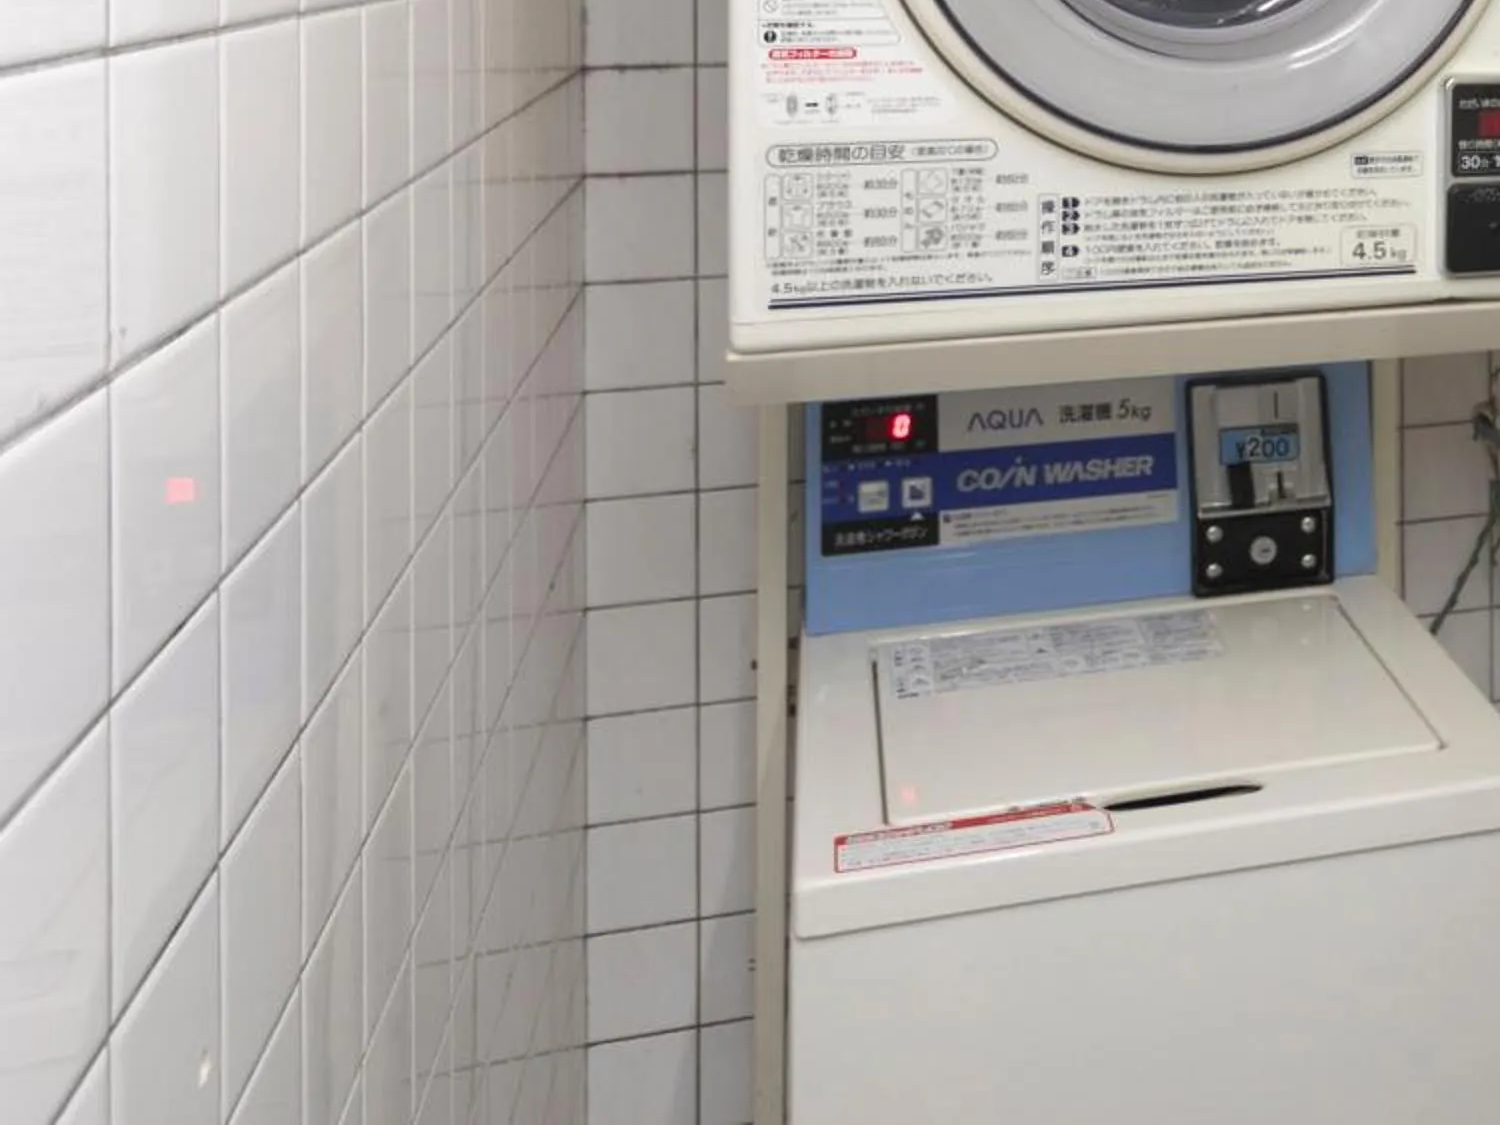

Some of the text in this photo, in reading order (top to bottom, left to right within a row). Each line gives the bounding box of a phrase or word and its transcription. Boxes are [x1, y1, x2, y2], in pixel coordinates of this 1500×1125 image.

[778, 144, 905, 163] 乾燥時間の目安
[967, 407, 1045, 433] AQUA
[1059, 398, 1152, 424] 洗濯機 5kg
[1043, 454, 1155, 485] WASHER
